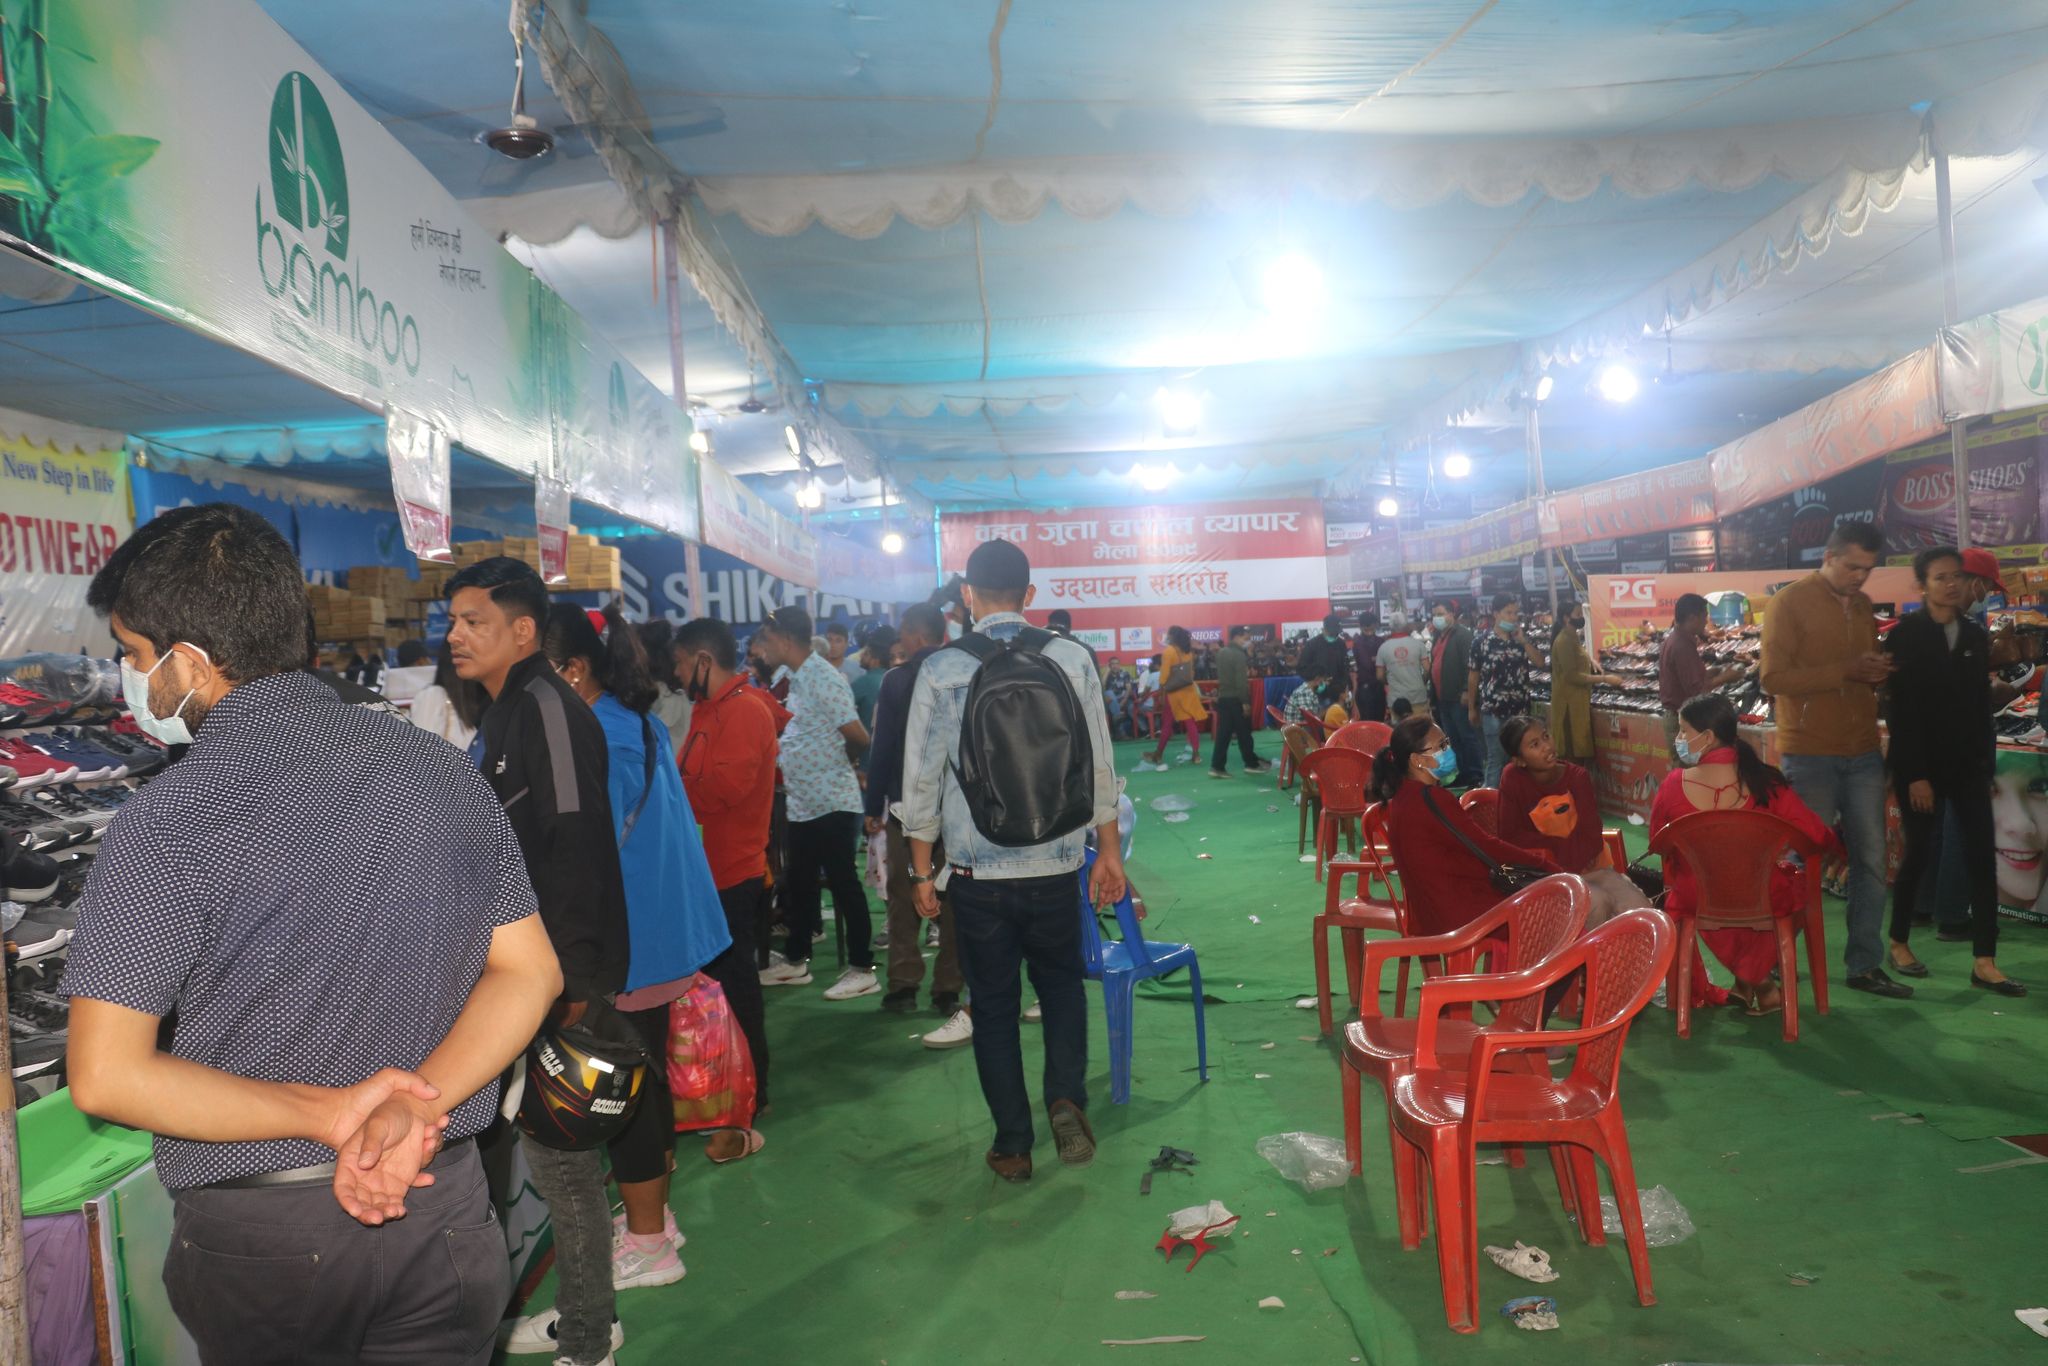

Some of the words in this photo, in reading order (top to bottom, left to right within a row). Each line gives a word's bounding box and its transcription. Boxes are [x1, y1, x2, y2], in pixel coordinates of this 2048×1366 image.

[256, 183, 420, 377] bamboo
[3, 453, 37, 481] New
[42, 460, 73, 495] Step
[75, 465, 91, 490] in
[92, 467, 115, 494] life
[1904, 472, 1953, 504] BOSS
[1204, 512, 1301, 533] व्यापार
[1092, 541, 1138, 560] मेला
[662, 568, 892, 627] SHIKHA
[1609, 580, 1656, 602] PG
[1190, 629, 1222, 641] SHOES
[589, 1097, 627, 1115] STUDDS
